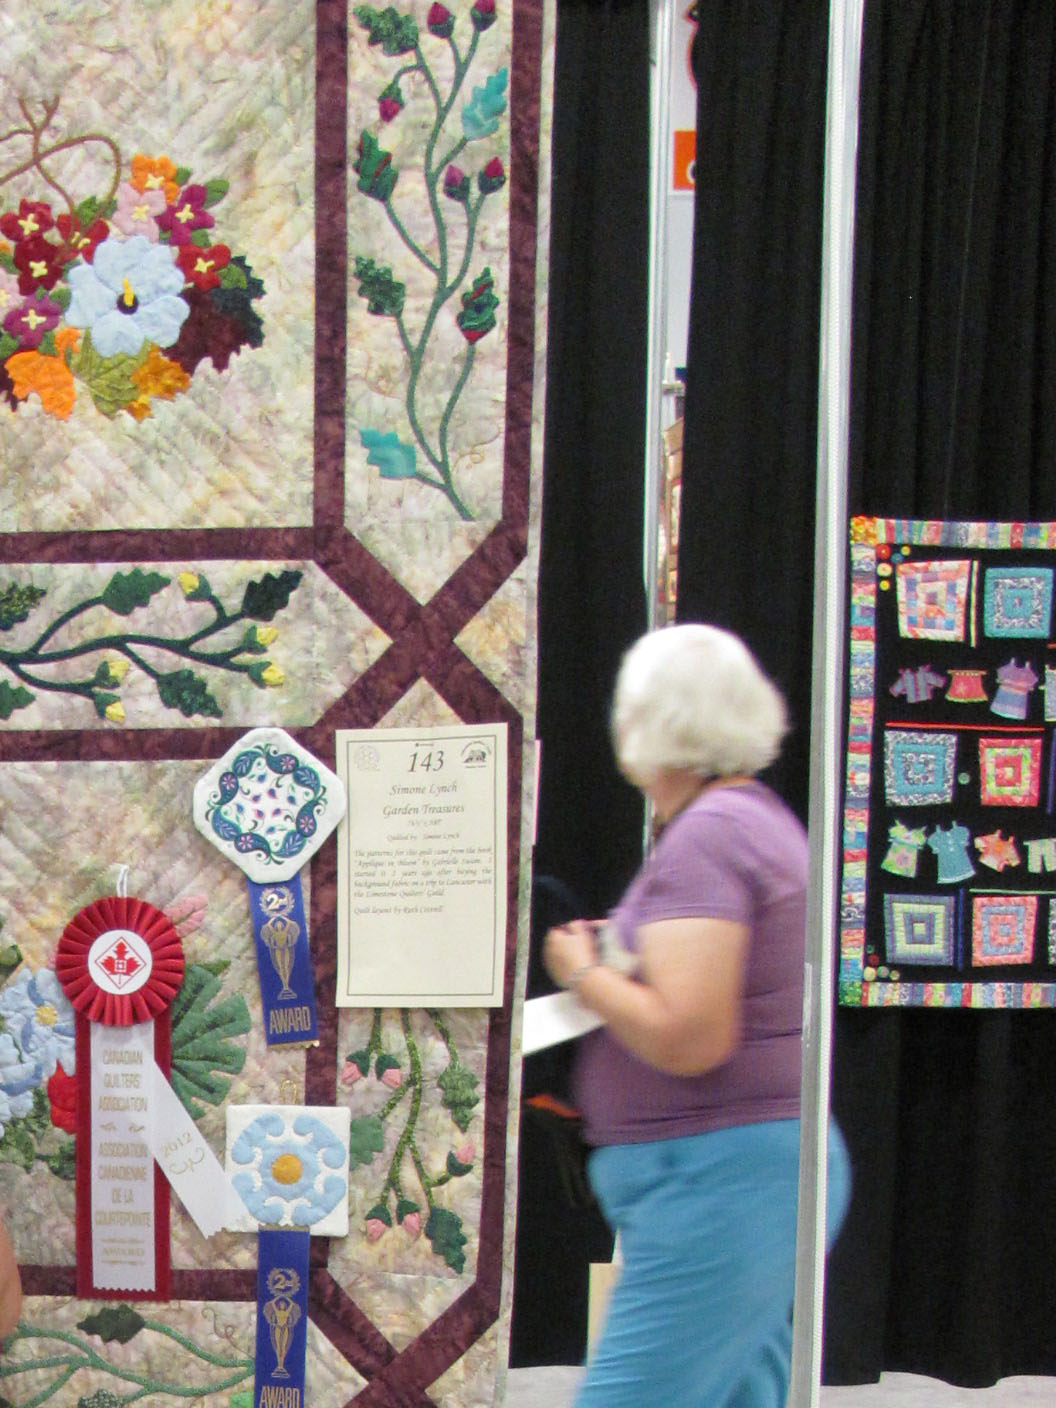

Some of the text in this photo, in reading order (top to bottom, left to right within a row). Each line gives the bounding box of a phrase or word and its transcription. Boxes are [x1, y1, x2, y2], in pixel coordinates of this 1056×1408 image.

[407, 750, 445, 773] 143
[389, 780, 458, 797] Simone Lynch
[382, 802, 465, 819] Garden Treasures
[269, 1006, 312, 1034] AWARD
[102, 1049, 143, 1065] CANADIAN
[162, 1132, 193, 1158] 2012
